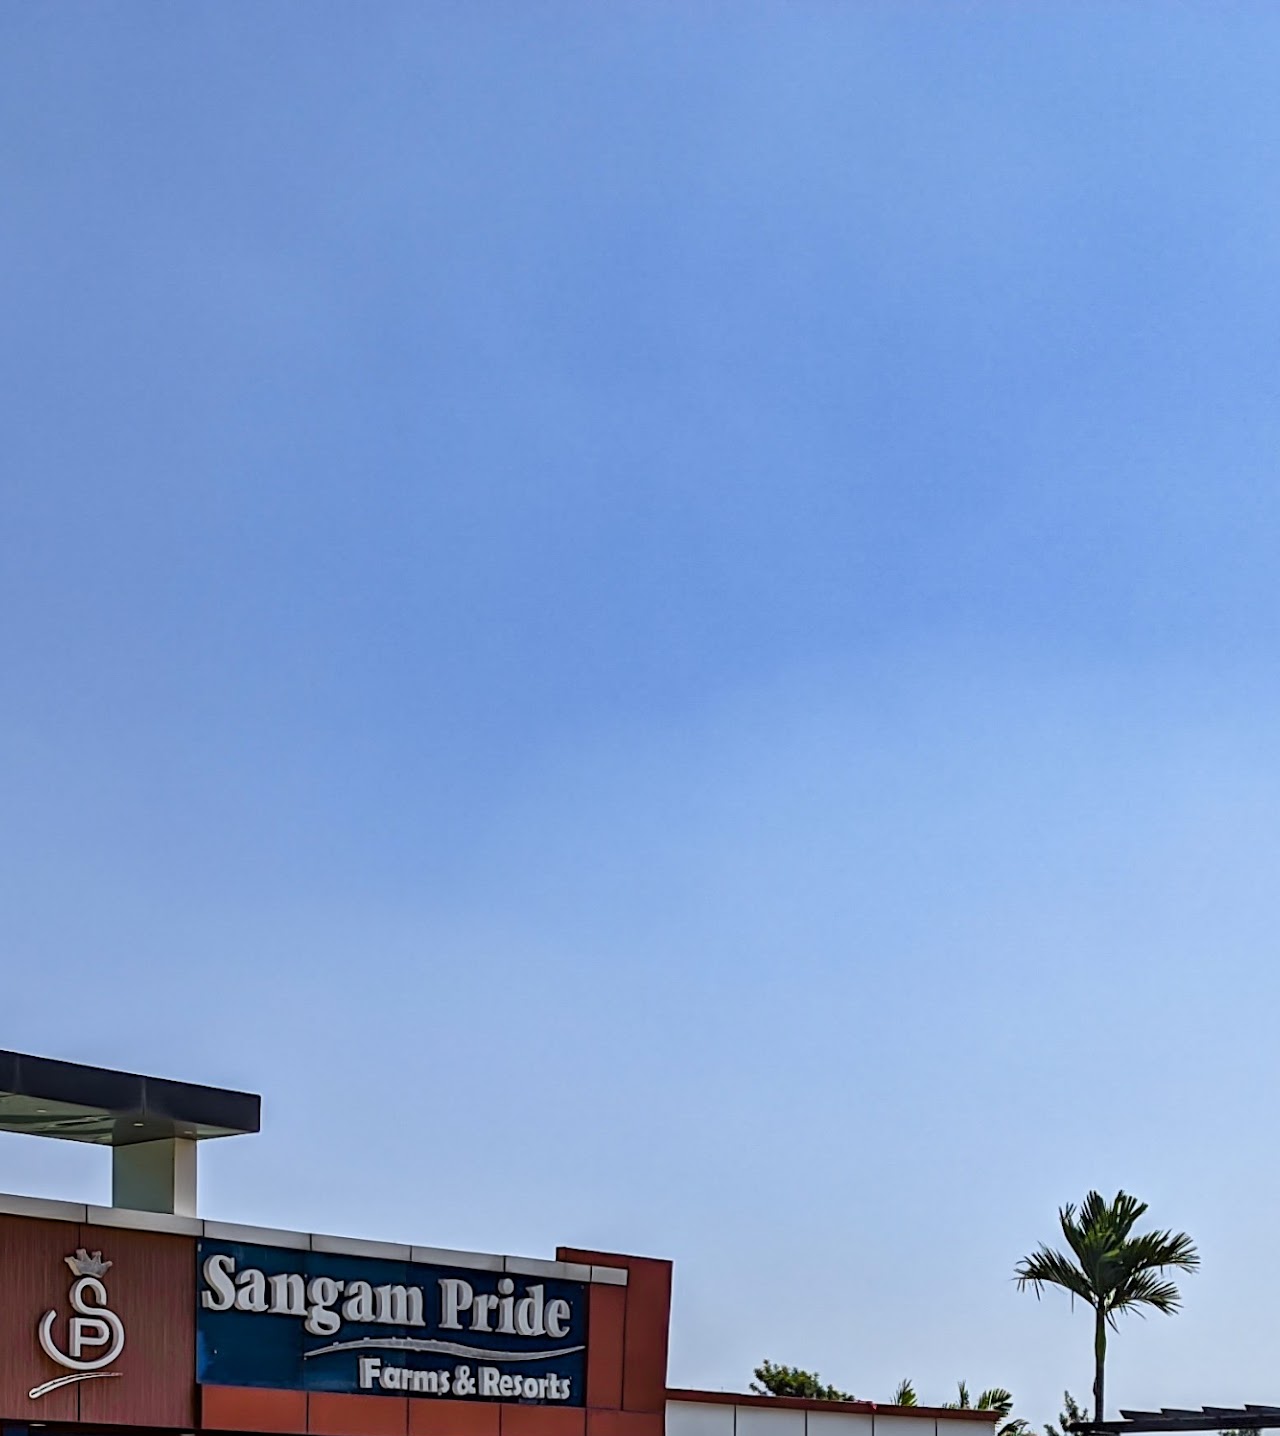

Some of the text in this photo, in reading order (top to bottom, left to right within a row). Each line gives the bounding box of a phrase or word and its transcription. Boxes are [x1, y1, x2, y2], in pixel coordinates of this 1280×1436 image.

[201, 1254, 571, 1338] Sangam Pride
[358, 1357, 571, 1400] Farms & Resorts
